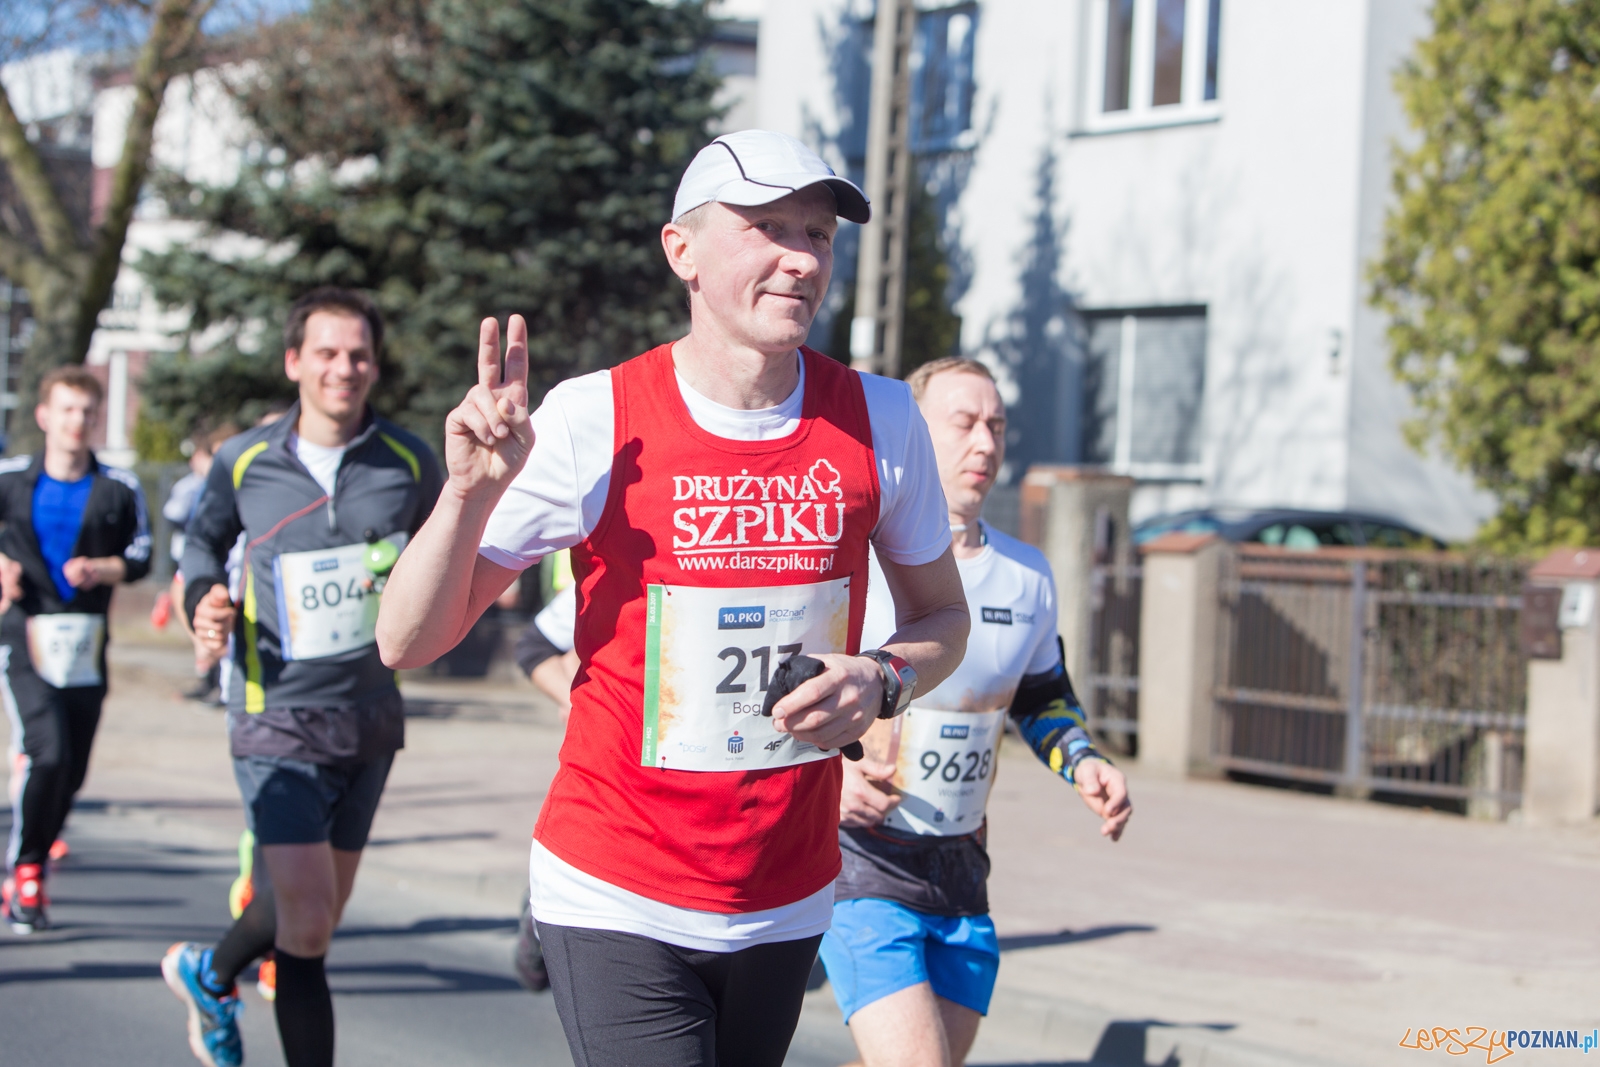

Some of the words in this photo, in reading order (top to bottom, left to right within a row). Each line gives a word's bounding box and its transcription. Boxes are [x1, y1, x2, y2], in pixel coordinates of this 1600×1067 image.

[673, 469, 819, 501] DRUŻYNA
[673, 502, 846, 549] SZPIKU
[677, 552, 834, 574] www.darszpiku.pl
[302, 577, 364, 611] 804
[723, 613, 737, 624] 10.
[738, 612, 762, 623] PKO
[733, 701, 761, 717] Bog
[919, 748, 992, 783] 9628
